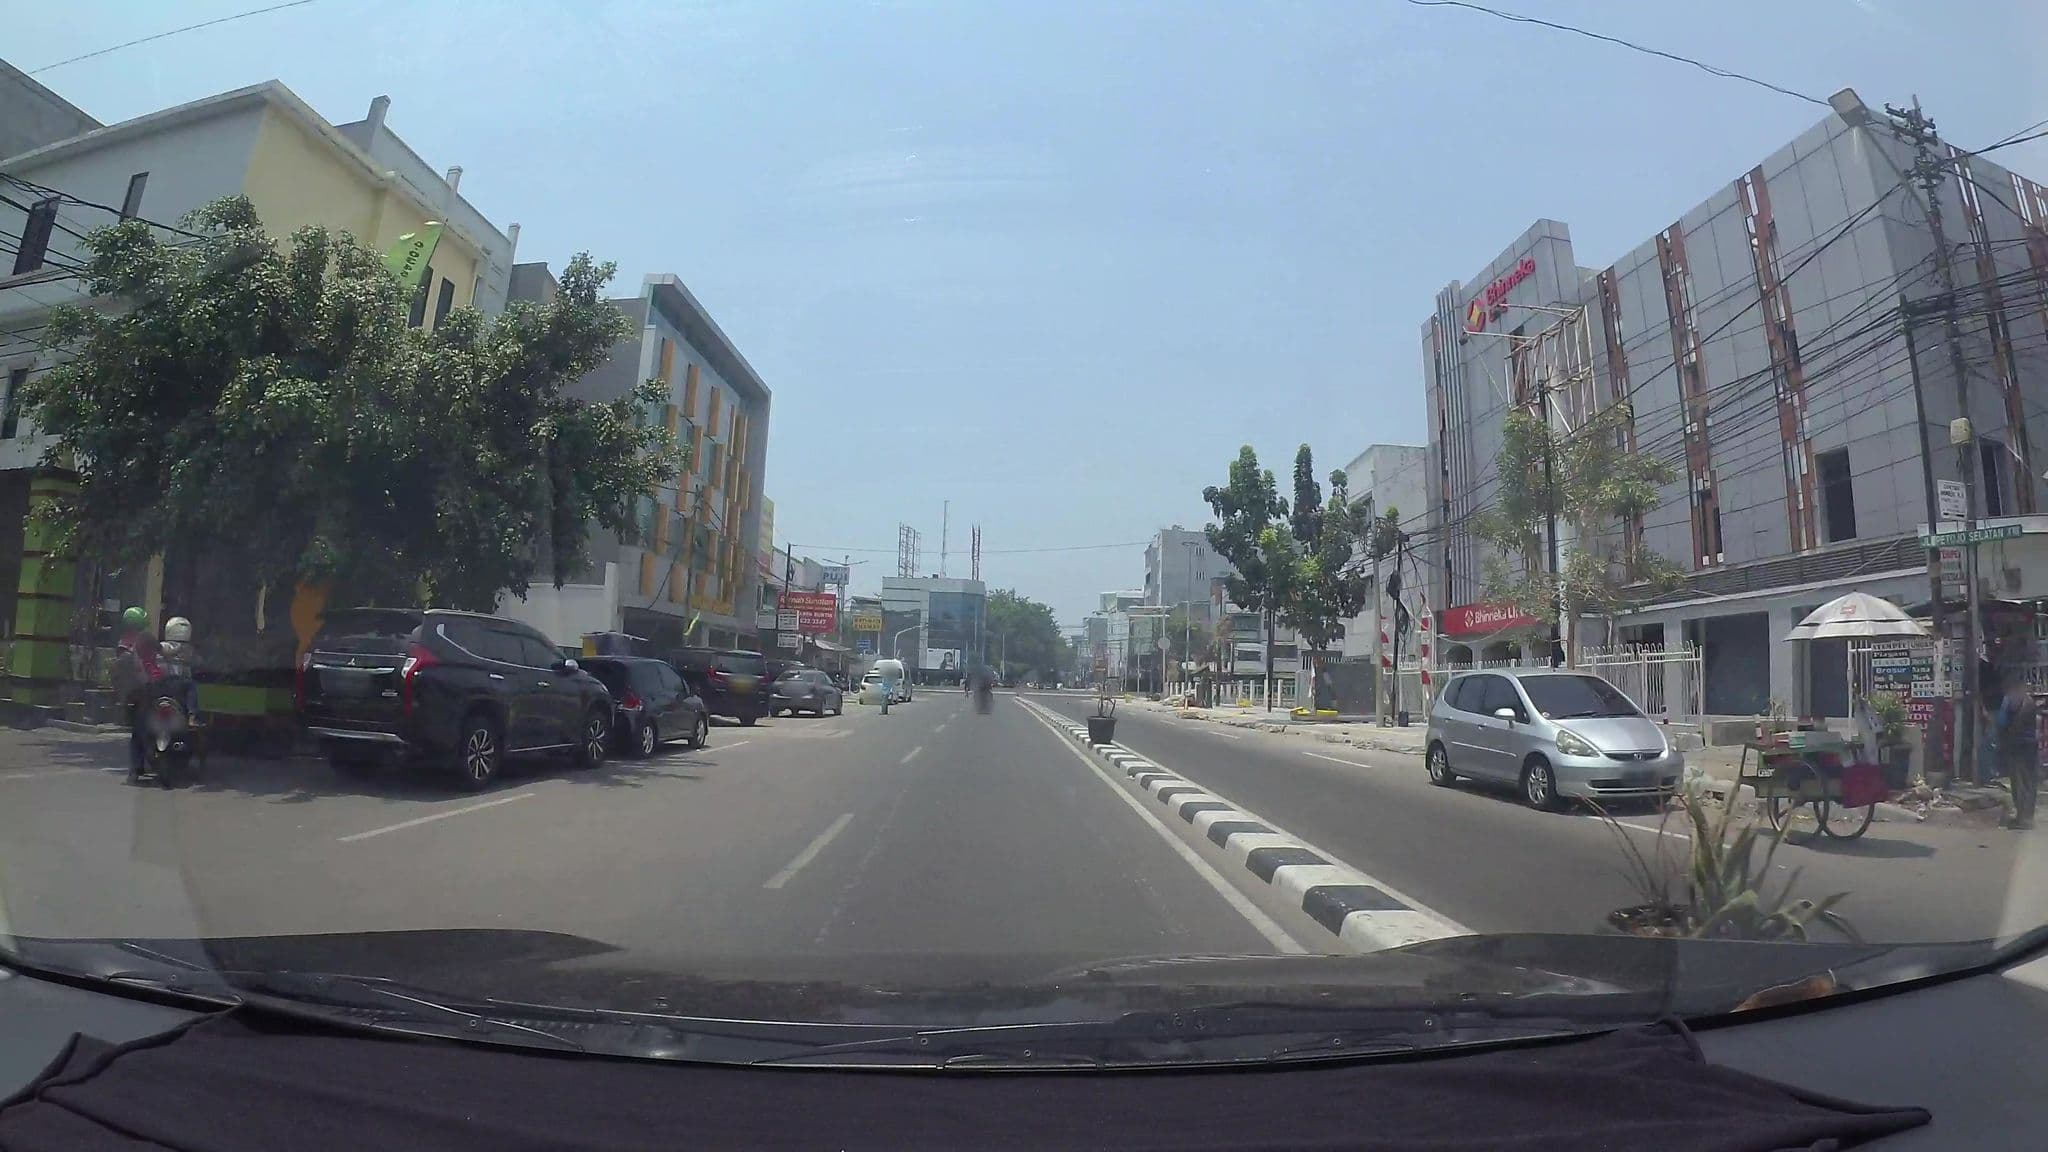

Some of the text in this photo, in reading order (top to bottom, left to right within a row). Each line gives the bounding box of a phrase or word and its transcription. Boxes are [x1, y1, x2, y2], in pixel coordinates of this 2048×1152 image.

[1487, 257, 1536, 306] Bhinneka
[1968, 528, 2004, 542] SELATAN
[1475, 608, 1507, 624] Bhinneka
